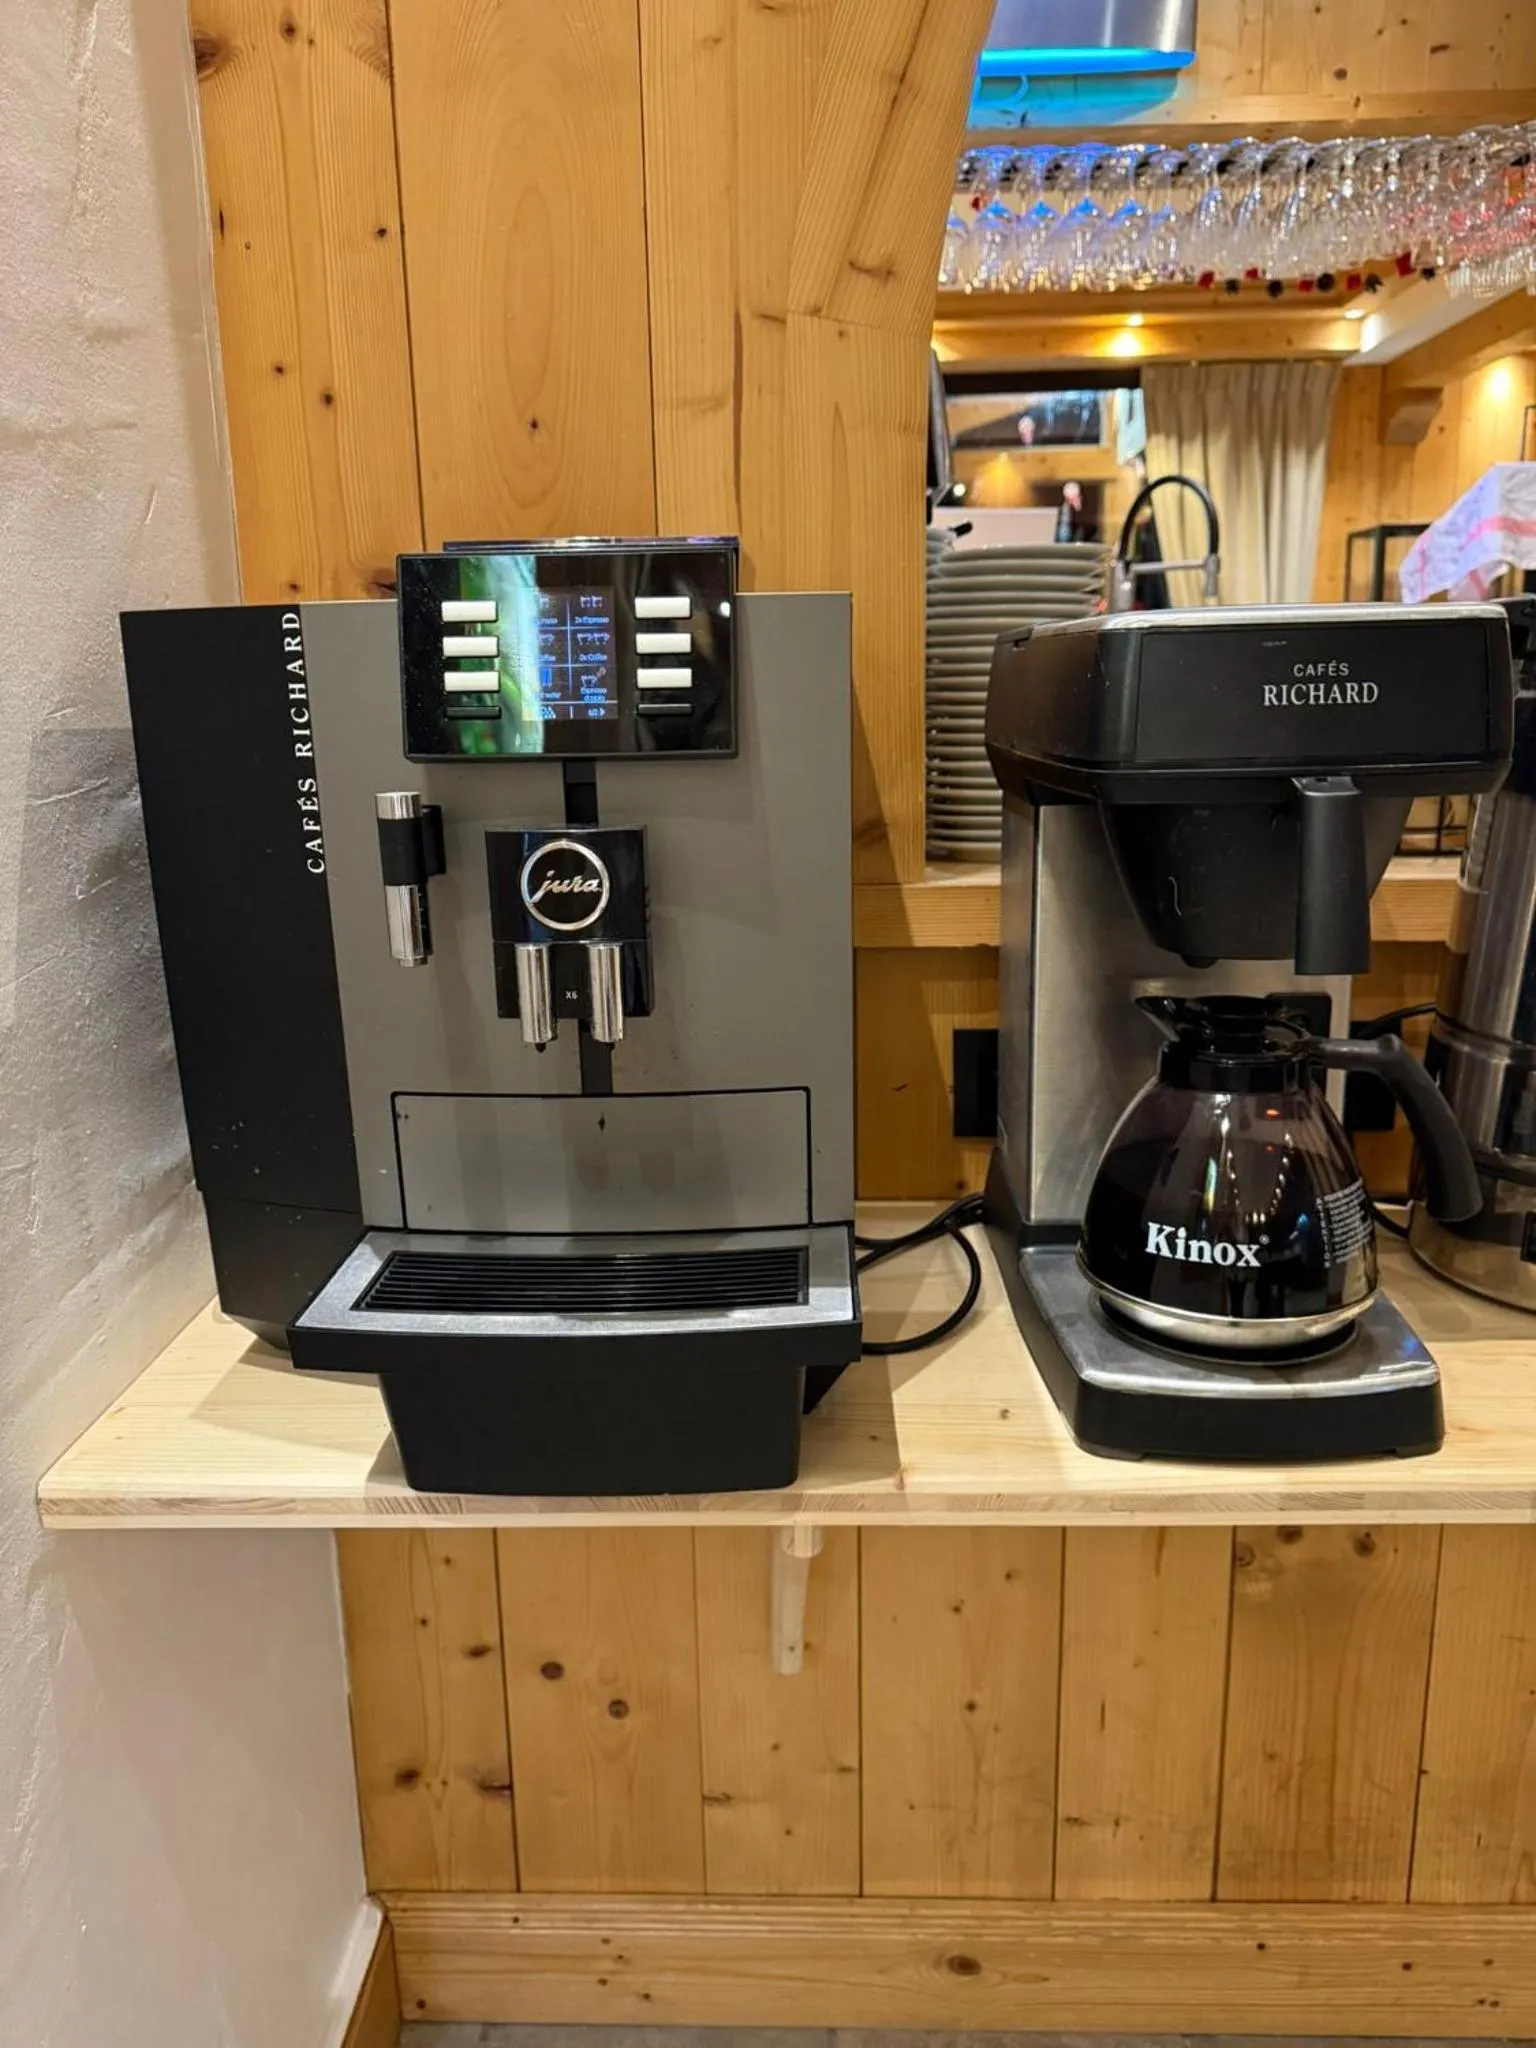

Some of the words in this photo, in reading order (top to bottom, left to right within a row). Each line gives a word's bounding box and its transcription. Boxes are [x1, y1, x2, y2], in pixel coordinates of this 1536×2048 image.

[282, 612, 313, 758] RICHARD
[1293, 660, 1349, 677] CAFÉS
[1263, 682, 1379, 706] RICHARD
[297, 778, 325, 874] CAFÉS
[531, 870, 602, 905] jura
